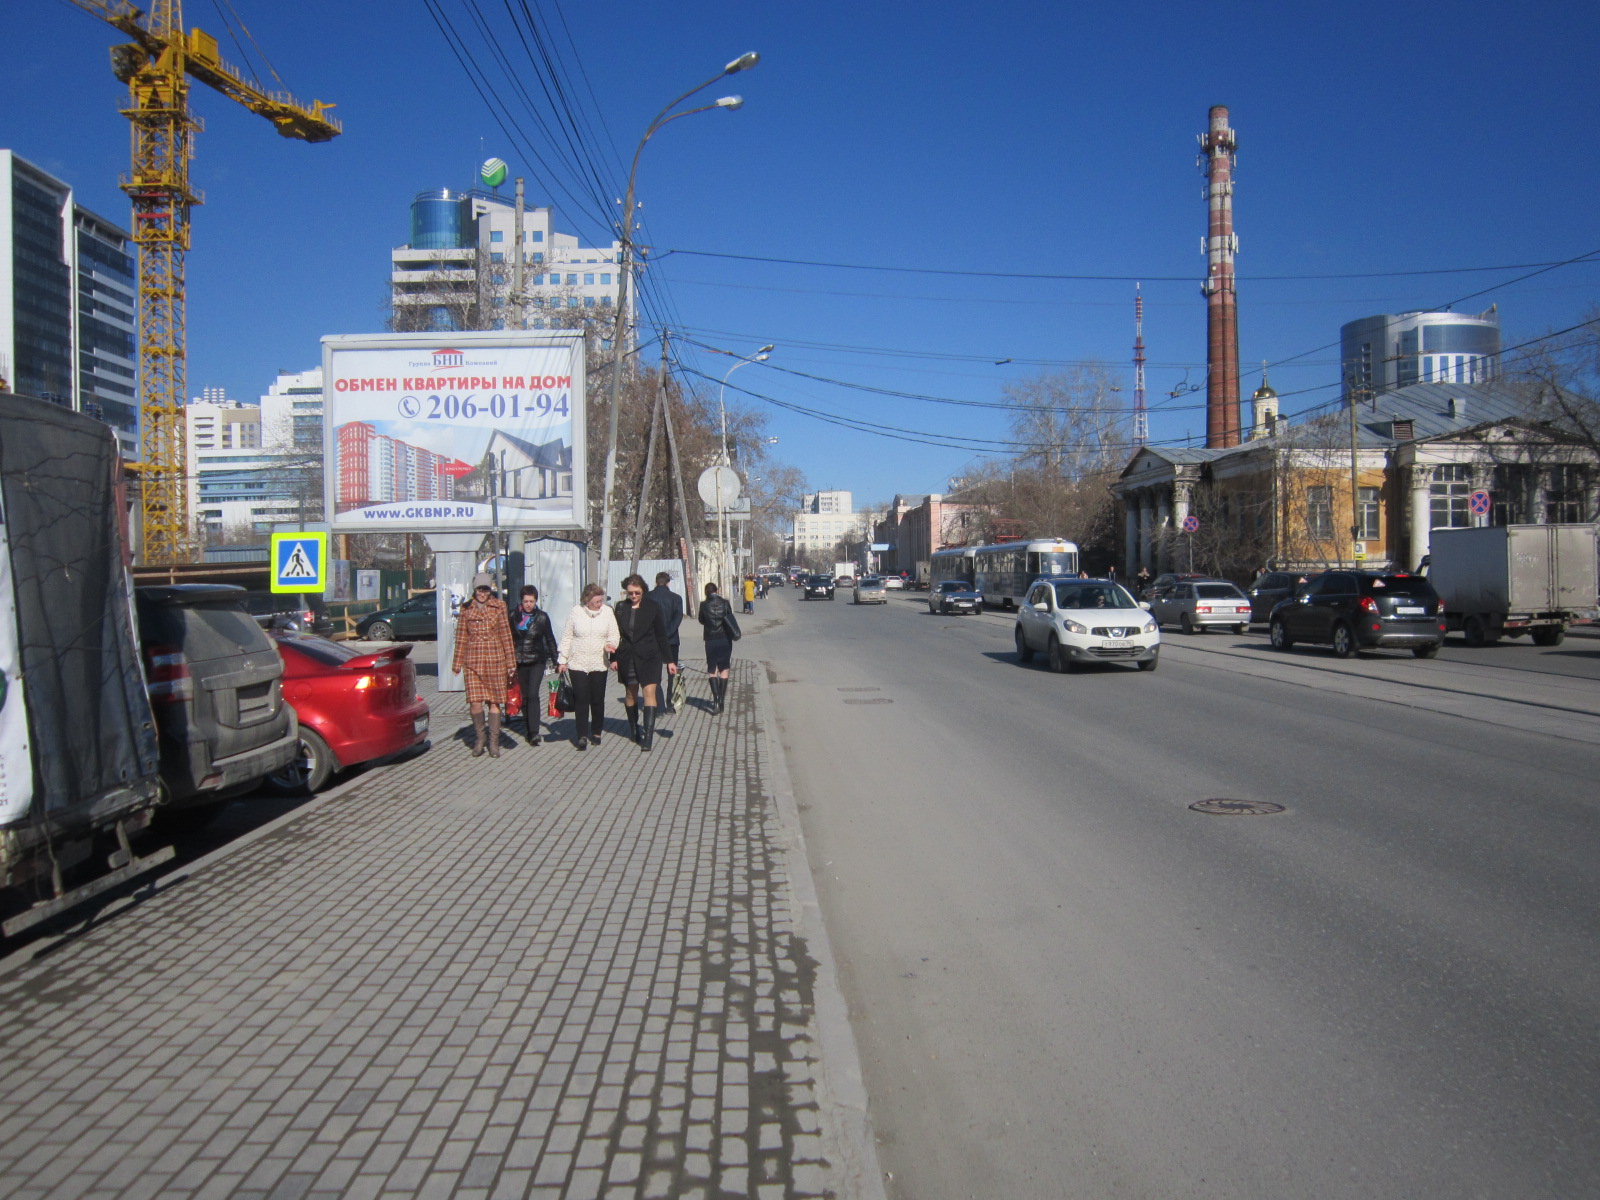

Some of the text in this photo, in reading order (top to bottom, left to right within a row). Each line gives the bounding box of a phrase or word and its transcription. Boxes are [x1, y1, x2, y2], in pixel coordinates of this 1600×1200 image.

[433, 354, 464, 366] БНП
[335, 375, 571, 392] ОБМЕН КВАРТИРЫ НА ДОМ
[426, 393, 569, 419] 206-01-94
